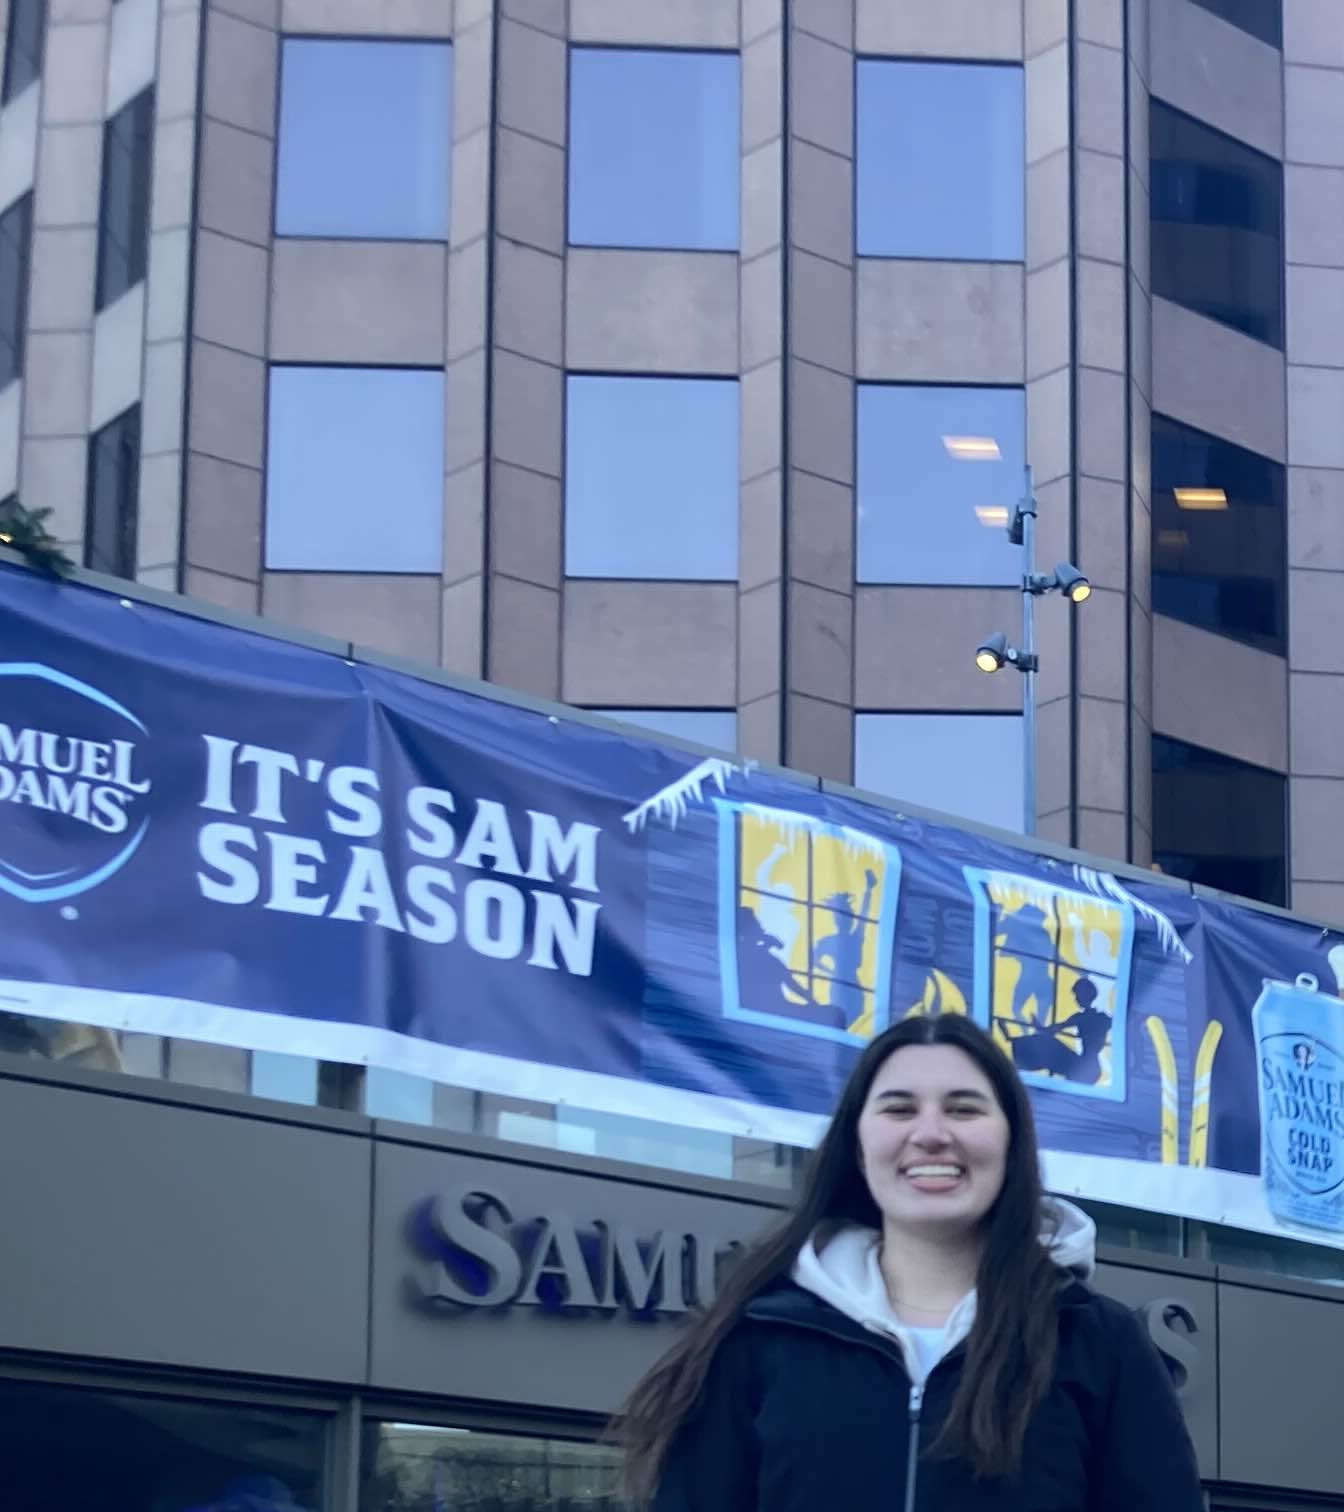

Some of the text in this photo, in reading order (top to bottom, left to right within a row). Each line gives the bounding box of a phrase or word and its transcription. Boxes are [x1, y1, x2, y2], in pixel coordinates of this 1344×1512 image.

[198, 733, 601, 893] IT'S SAM
[197, 822, 601, 977] SEASON
[1287, 1147, 1333, 1174] SNAP
[1288, 1127, 1331, 1154] COLD
